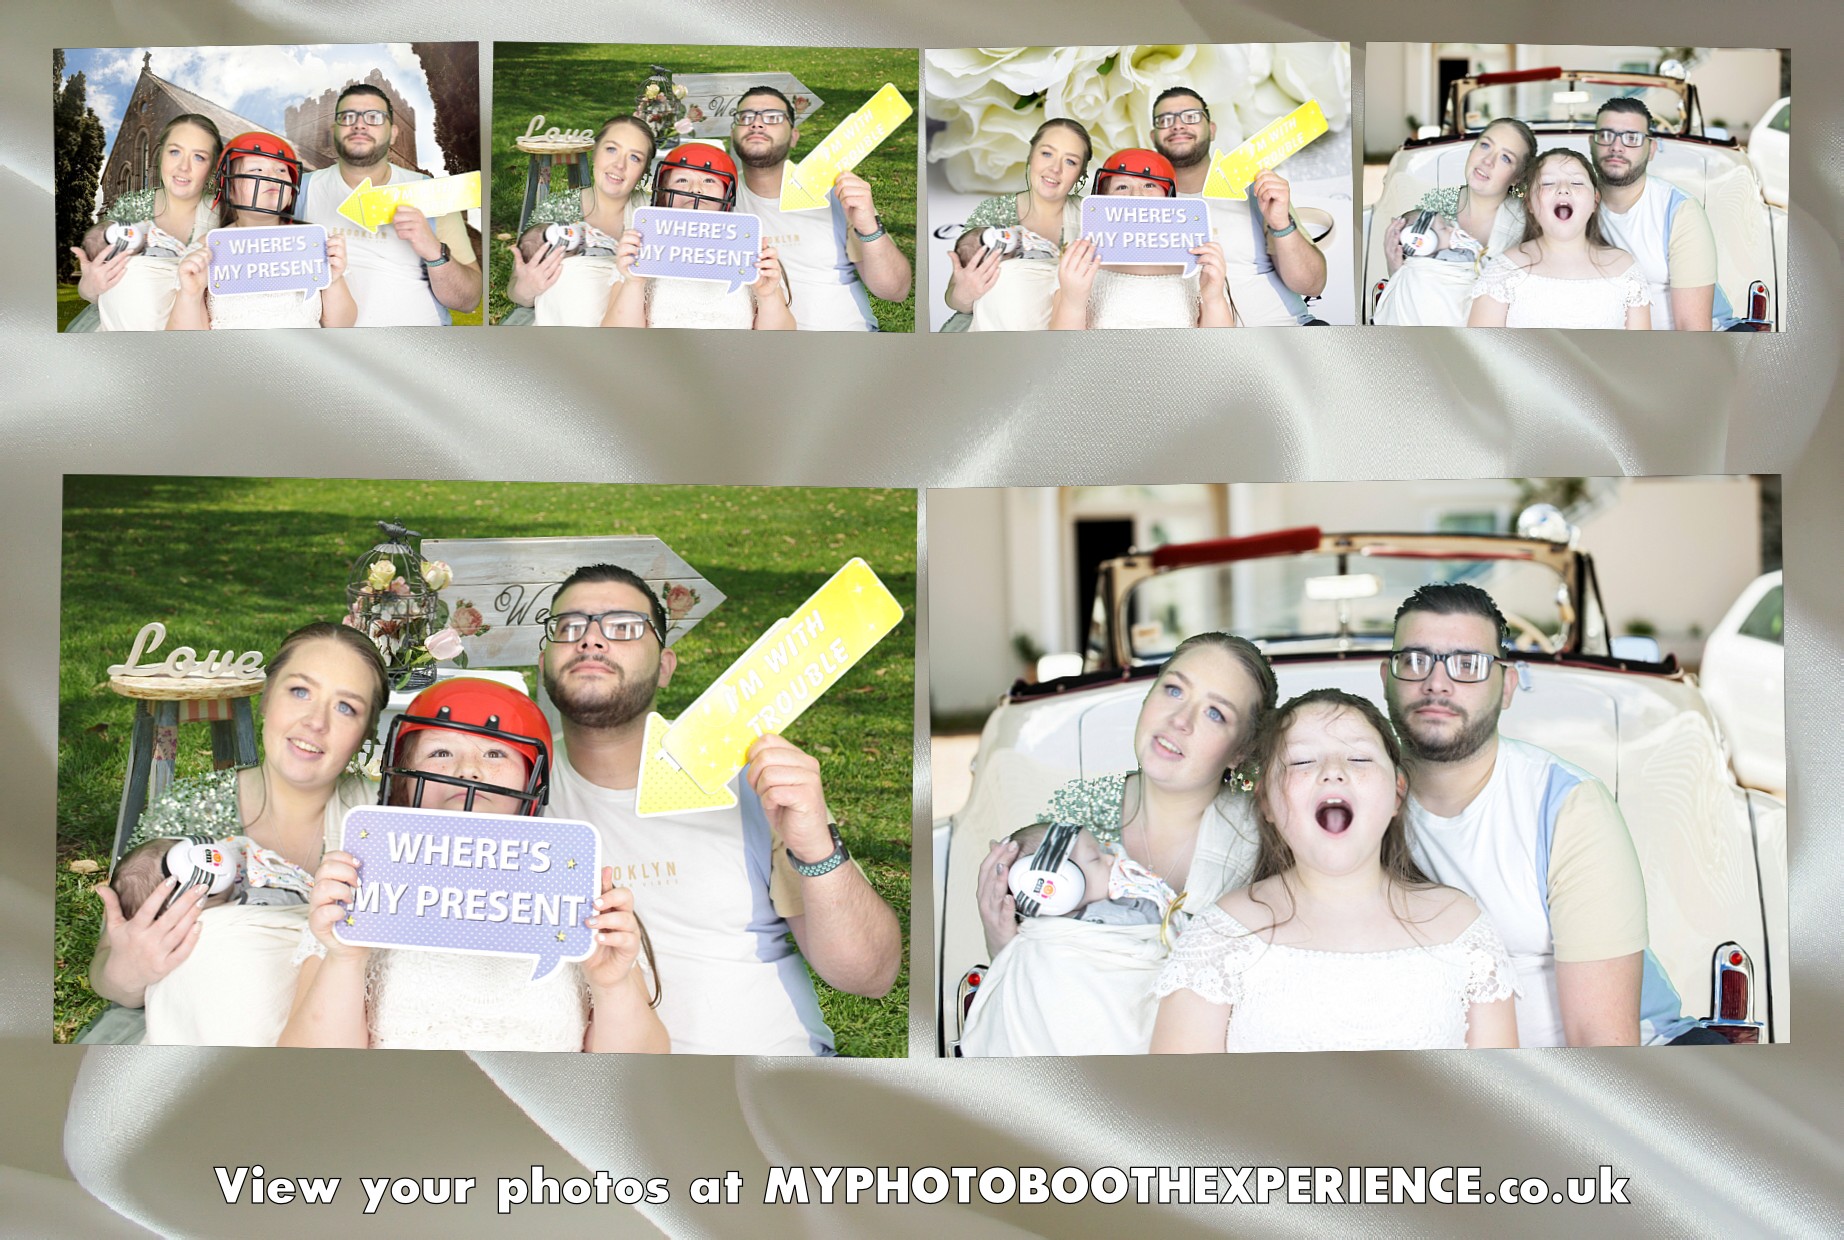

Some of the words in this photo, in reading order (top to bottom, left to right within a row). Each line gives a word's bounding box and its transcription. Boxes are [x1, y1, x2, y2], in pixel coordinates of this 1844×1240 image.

[515, 114, 595, 144] Love
[843, 108, 875, 140] WITH
[1268, 116, 1298, 141] WITH
[834, 122, 886, 173] TROUBLE
[1256, 131, 1305, 170] TROUBLE
[655, 219, 738, 240] WHERE'S
[1105, 207, 1187, 224] WHERE'S
[229, 236, 307, 255] WHERE'S
[1088, 231, 1119, 248] MY
[1123, 232, 1207, 248] PRESENT
[214, 264, 242, 281] MY
[247, 258, 324, 279] PRESENT
[637, 244, 666, 261] MY
[669, 246, 754, 267] PRESENT
[107, 621, 266, 680] Love
[724, 670, 764, 714] I'M
[763, 609, 825, 674] WITH
[746, 637, 849, 738] TROUBLE
[387, 831, 552, 873] WHERE'S
[613, 862, 677, 881] OKLYN
[347, 881, 409, 915] MY
[416, 885, 587, 927] PRESENT
